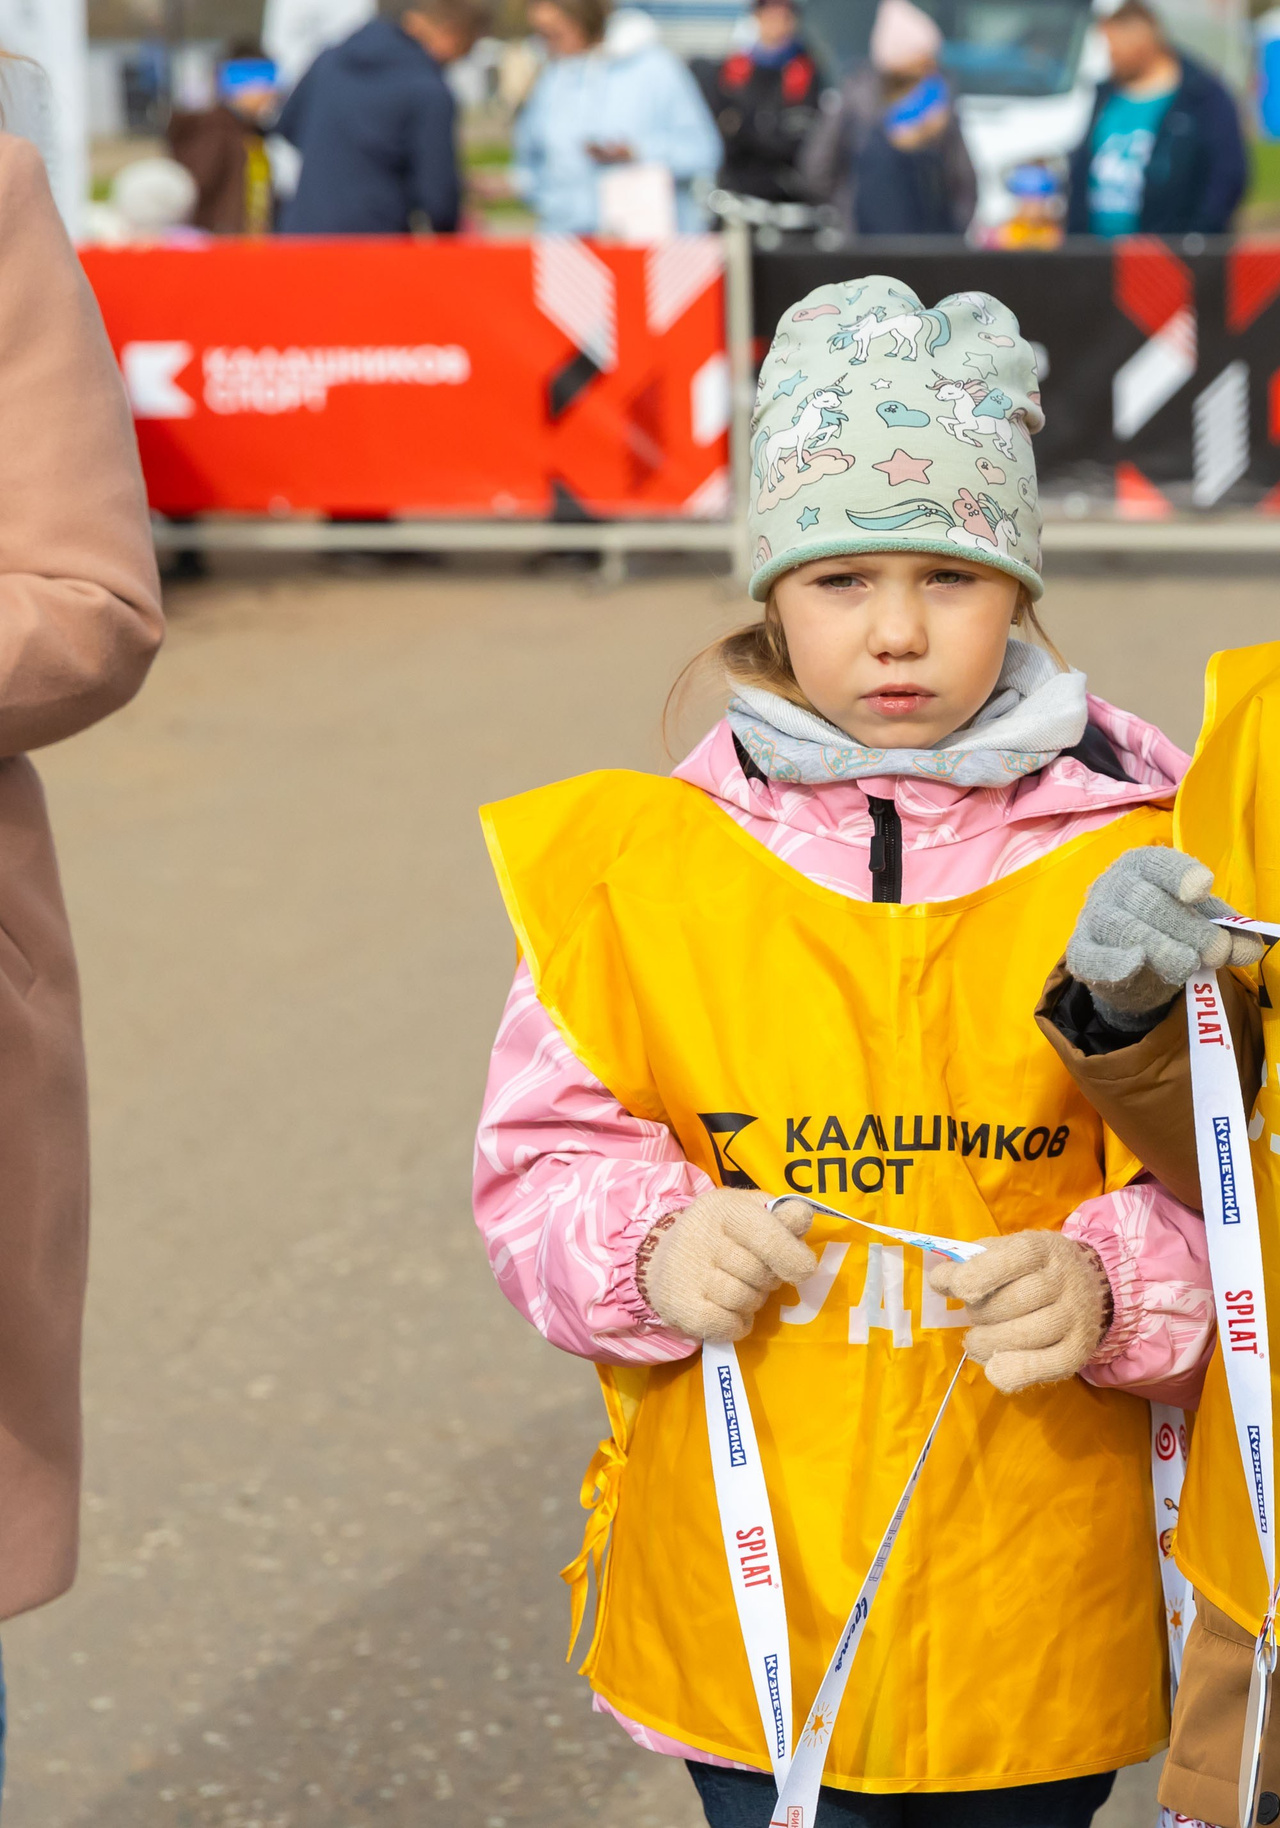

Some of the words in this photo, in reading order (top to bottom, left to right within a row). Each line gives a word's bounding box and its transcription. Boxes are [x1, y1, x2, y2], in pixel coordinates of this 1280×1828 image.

[1193, 983, 1224, 1046] SPLAT
[1225, 1290, 1258, 1354] SPLAT
[718, 1366, 746, 1467] КУЗНЕЧИКИ
[1248, 1426, 1267, 1533] КУЗНЕЧИКИ
[736, 1526, 772, 1587] SPLAT
[764, 1654, 784, 1758] КУЗНЕЧИКИ
